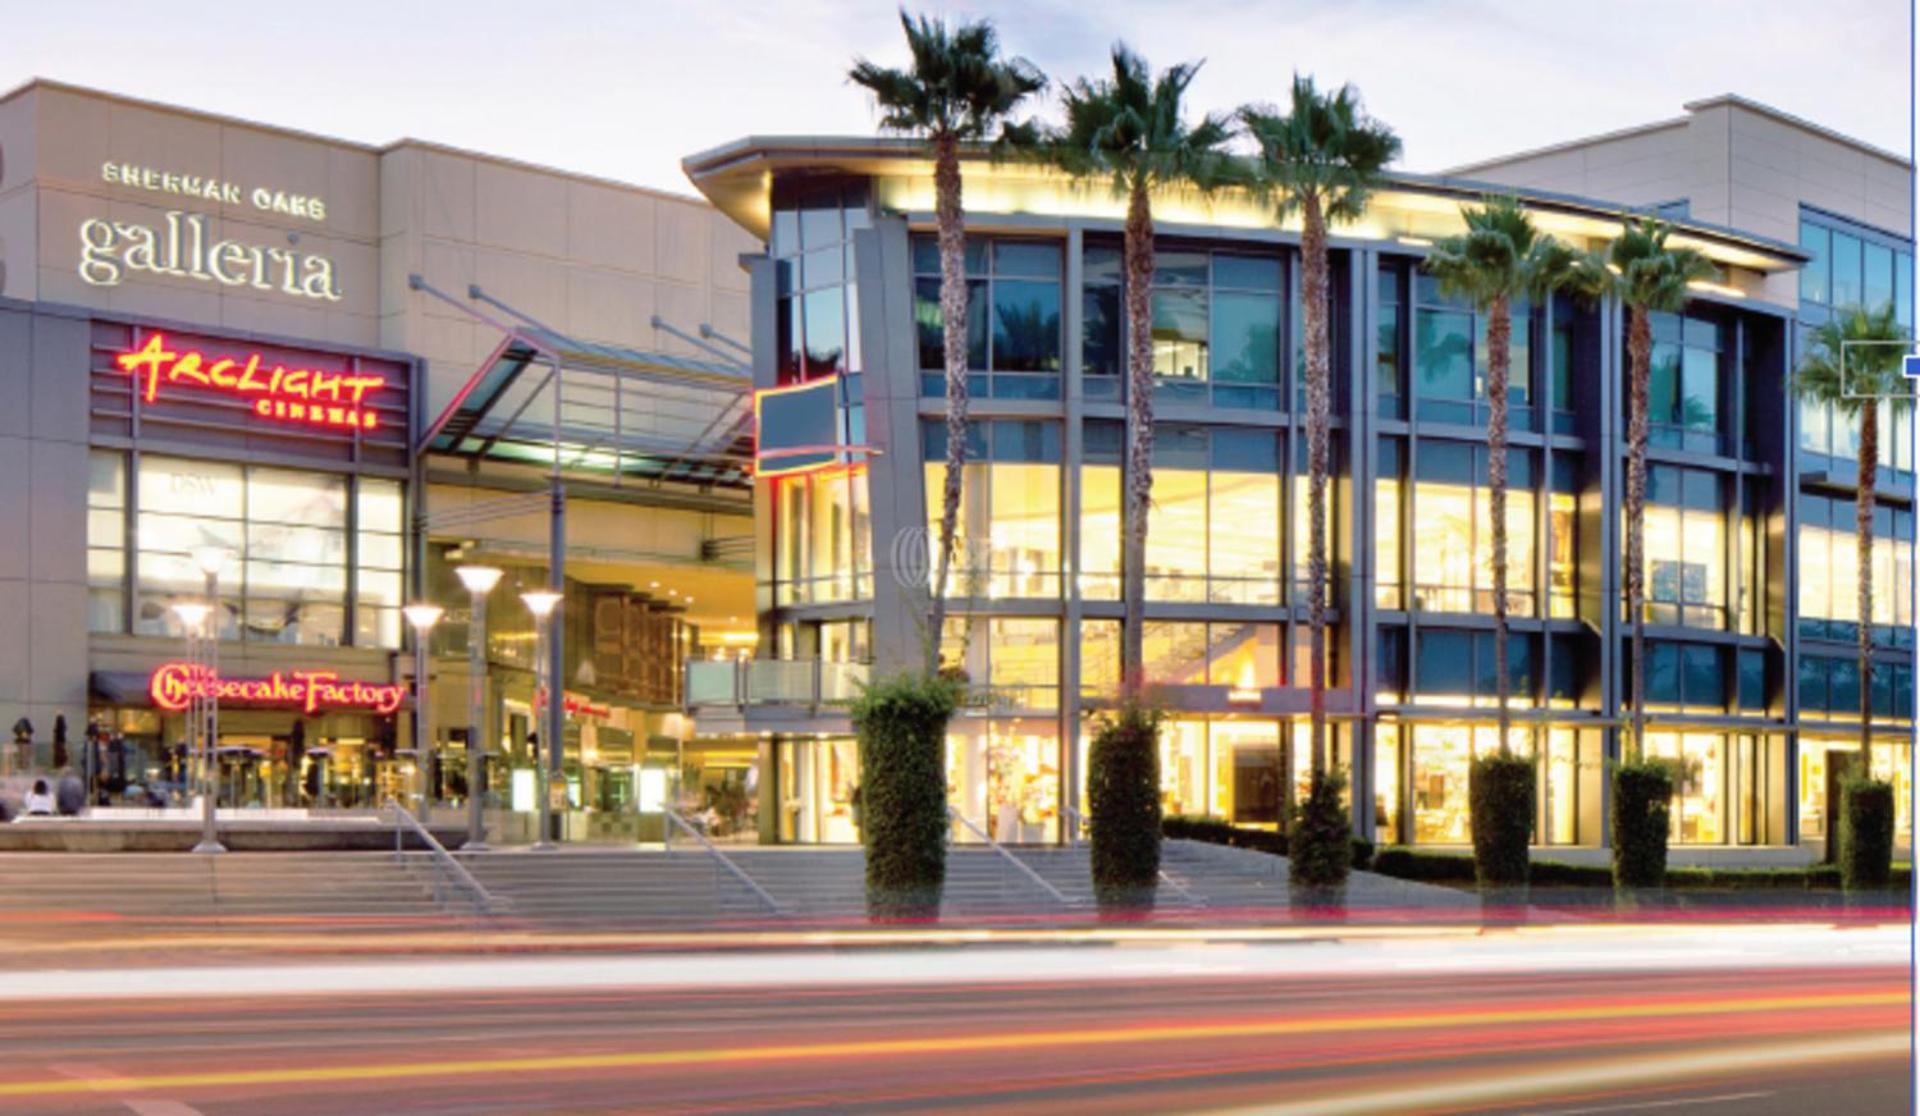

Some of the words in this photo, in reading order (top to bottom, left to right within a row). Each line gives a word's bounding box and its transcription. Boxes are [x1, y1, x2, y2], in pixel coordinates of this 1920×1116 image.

[101, 161, 242, 204] SHERMAN
[252, 186, 327, 221] OAKS
[78, 210, 344, 301] galleria
[256, 398, 379, 429] CINEMAS
[292, 671, 405, 713] Factory
